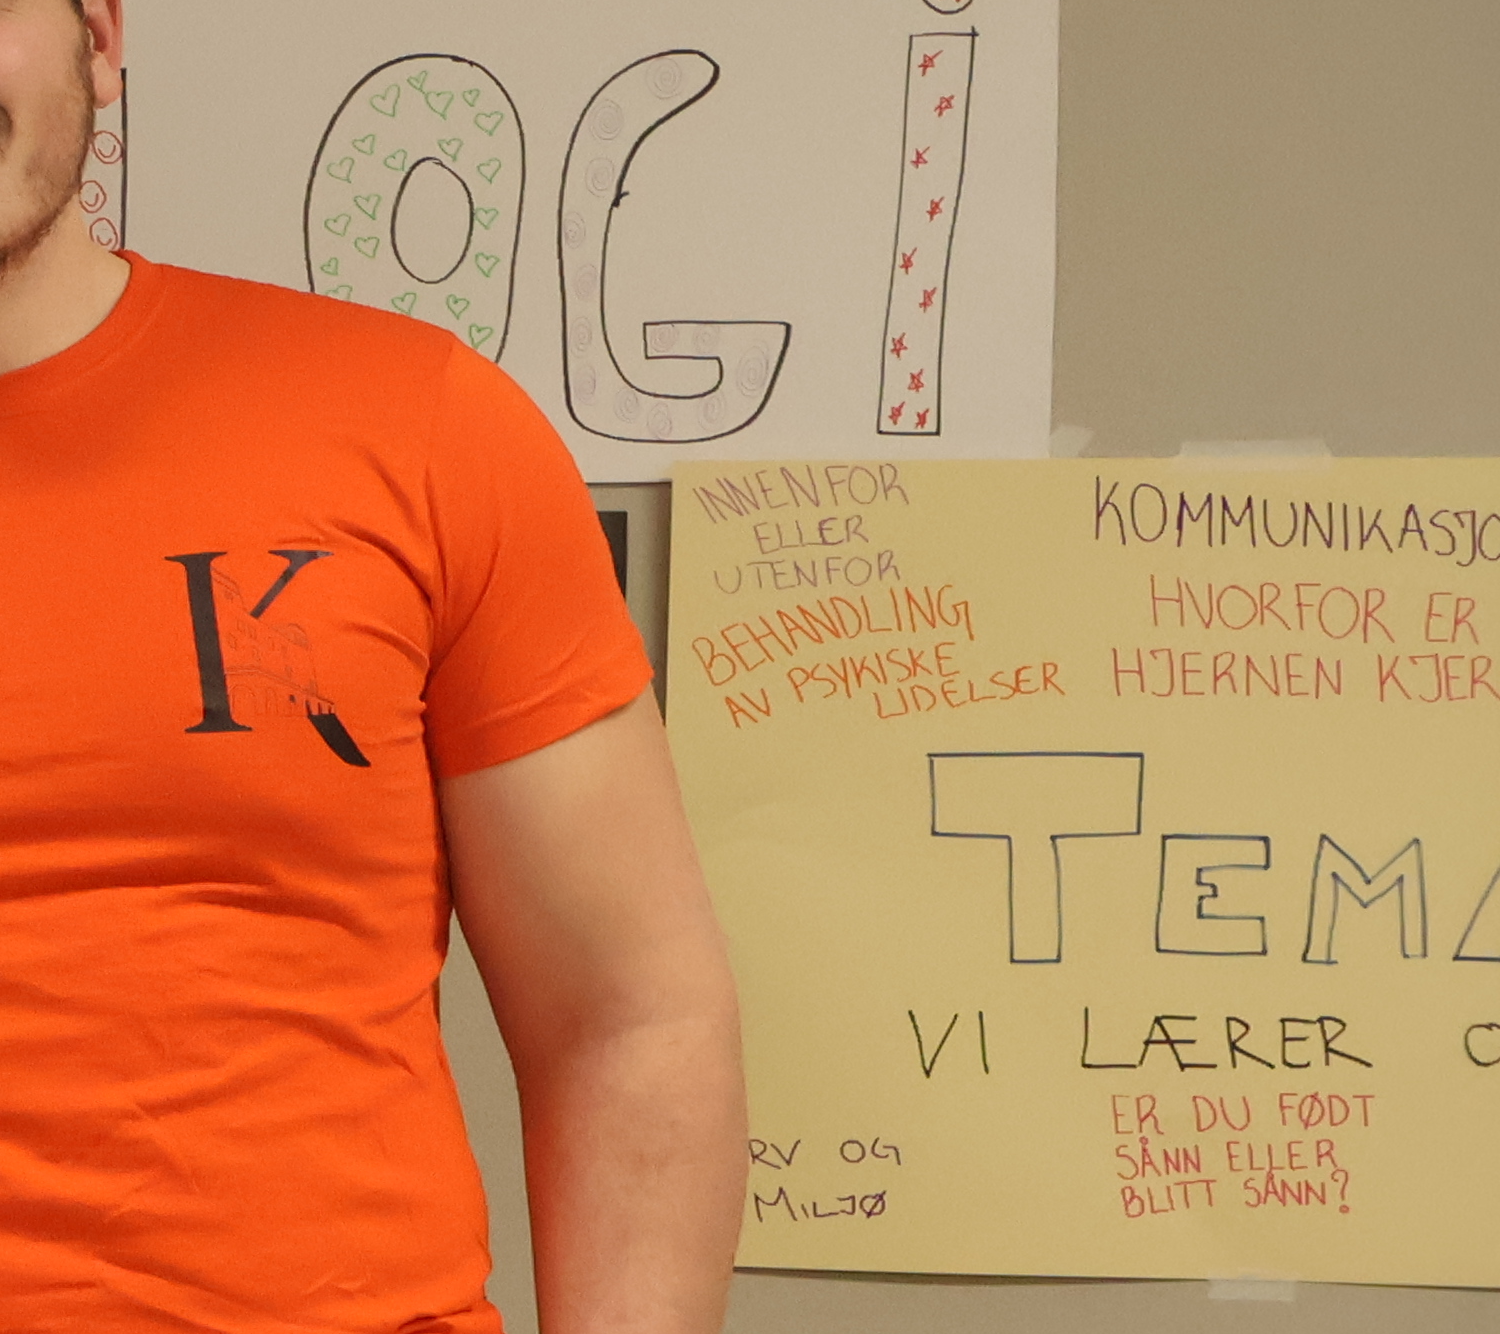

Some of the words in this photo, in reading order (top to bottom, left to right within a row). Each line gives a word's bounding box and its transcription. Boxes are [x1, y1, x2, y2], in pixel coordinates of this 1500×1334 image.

[692, 462, 910, 524] INNENFOR
[1094, 474, 1500, 568] KOMMUNIKASJO
[752, 513, 870, 556] ELLER
[712, 548, 901, 595] UTENFOR
[691, 584, 976, 688] BEHANDLING
[1149, 573, 1396, 644] HVORFOR
[1424, 591, 1480, 646] ER
[723, 688, 772, 730] AV
[786, 641, 962, 704] PSYKISKE
[872, 661, 1067, 720] LIDELSER
[1110, 646, 1344, 701] HJERNEN
[1376, 652, 1500, 704] KJER
[907, 1009, 990, 1079] VI
[1080, 1006, 1374, 1072] LÆRER
[1110, 1093, 1165, 1136] ER
[1191, 1093, 1251, 1133] DU
[1278, 1091, 1376, 1130] FØDT
[839, 1136, 902, 1167] OG
[1114, 1135, 1202, 1182] SÅNN
[1225, 1137, 1339, 1173] ELLER
[1120, 1178, 1218, 1219] BLITT
[1242, 1167, 1352, 1215] SÅNN?
